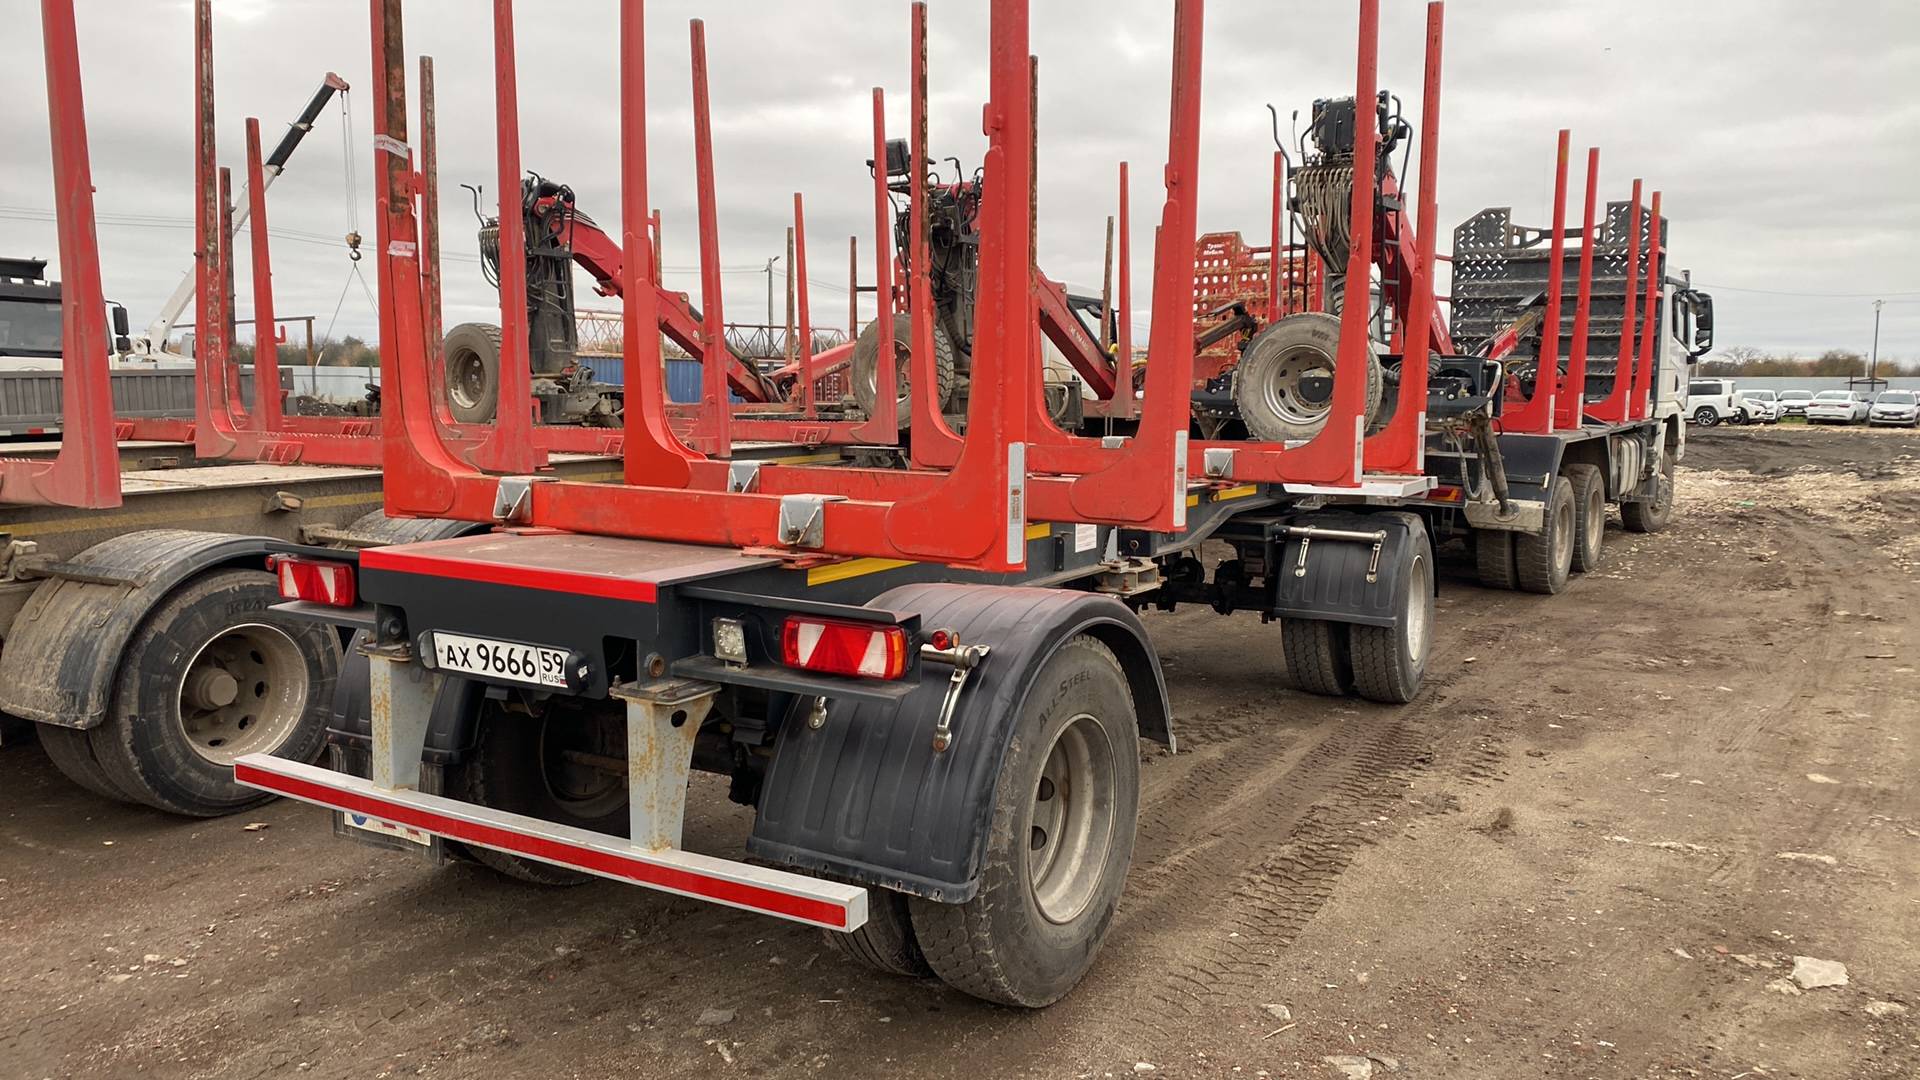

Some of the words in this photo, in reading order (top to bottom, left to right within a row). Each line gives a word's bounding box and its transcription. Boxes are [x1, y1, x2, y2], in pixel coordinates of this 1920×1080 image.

[446, 645, 472, 669] АХ
[476, 643, 536, 677] 9666
[541, 651, 564, 674] 59
[542, 673, 560, 683] RUS
